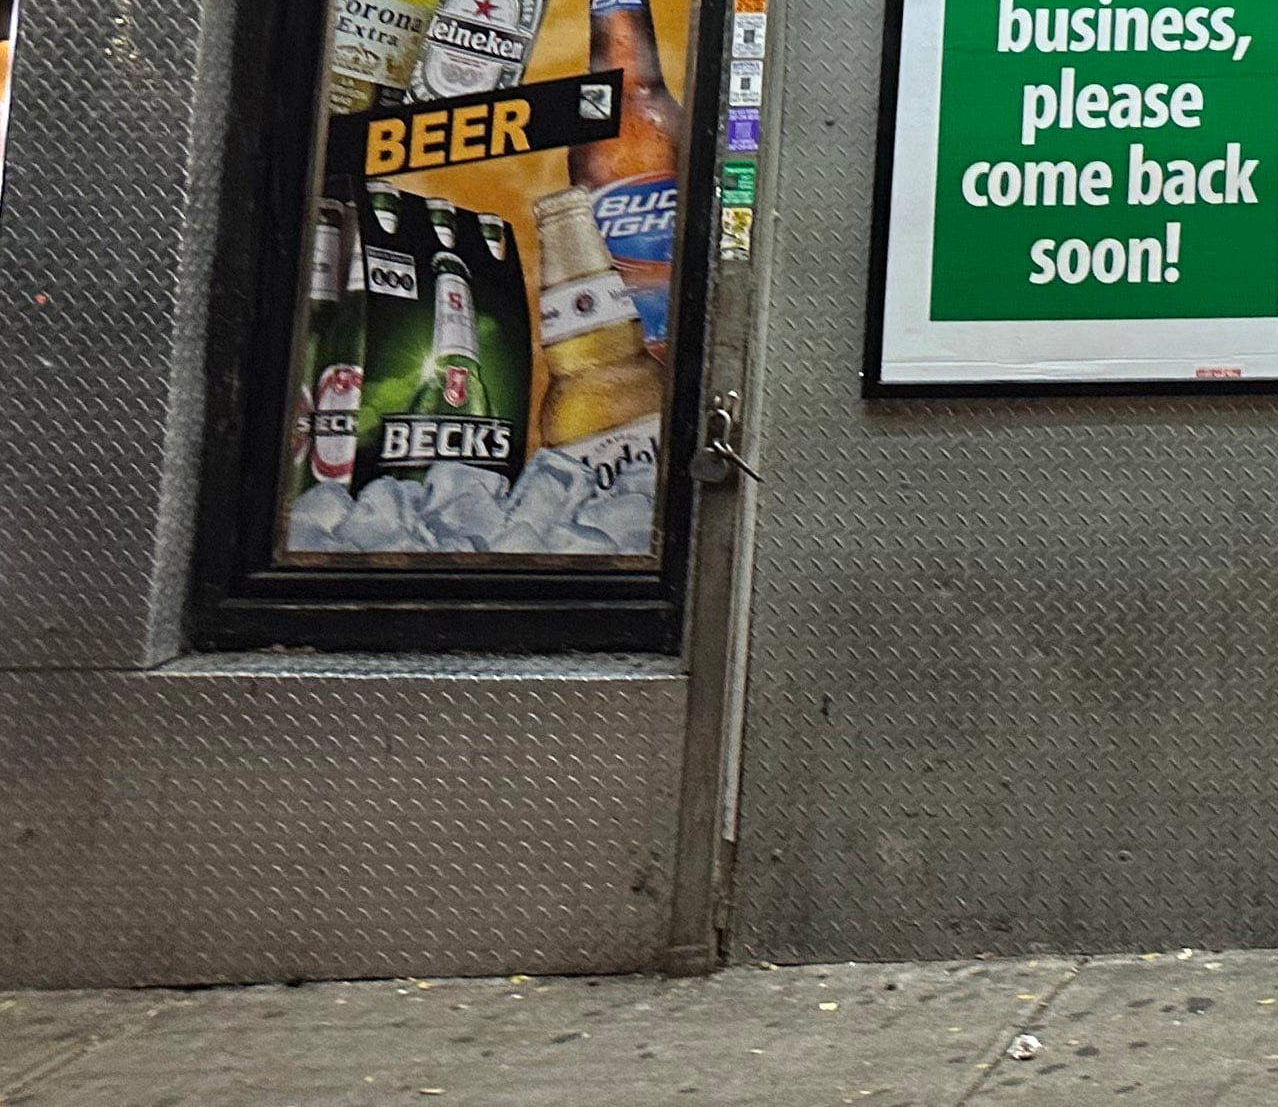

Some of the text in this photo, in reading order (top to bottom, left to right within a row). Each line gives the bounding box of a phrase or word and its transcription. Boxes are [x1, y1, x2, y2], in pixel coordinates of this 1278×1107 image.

[335, 15, 400, 48] Extra
[365, 99, 531, 175] BEER
[1022, 68, 1203, 145] please
[962, 142, 1259, 207] come back
[1029, 221, 1181, 284] soon!
